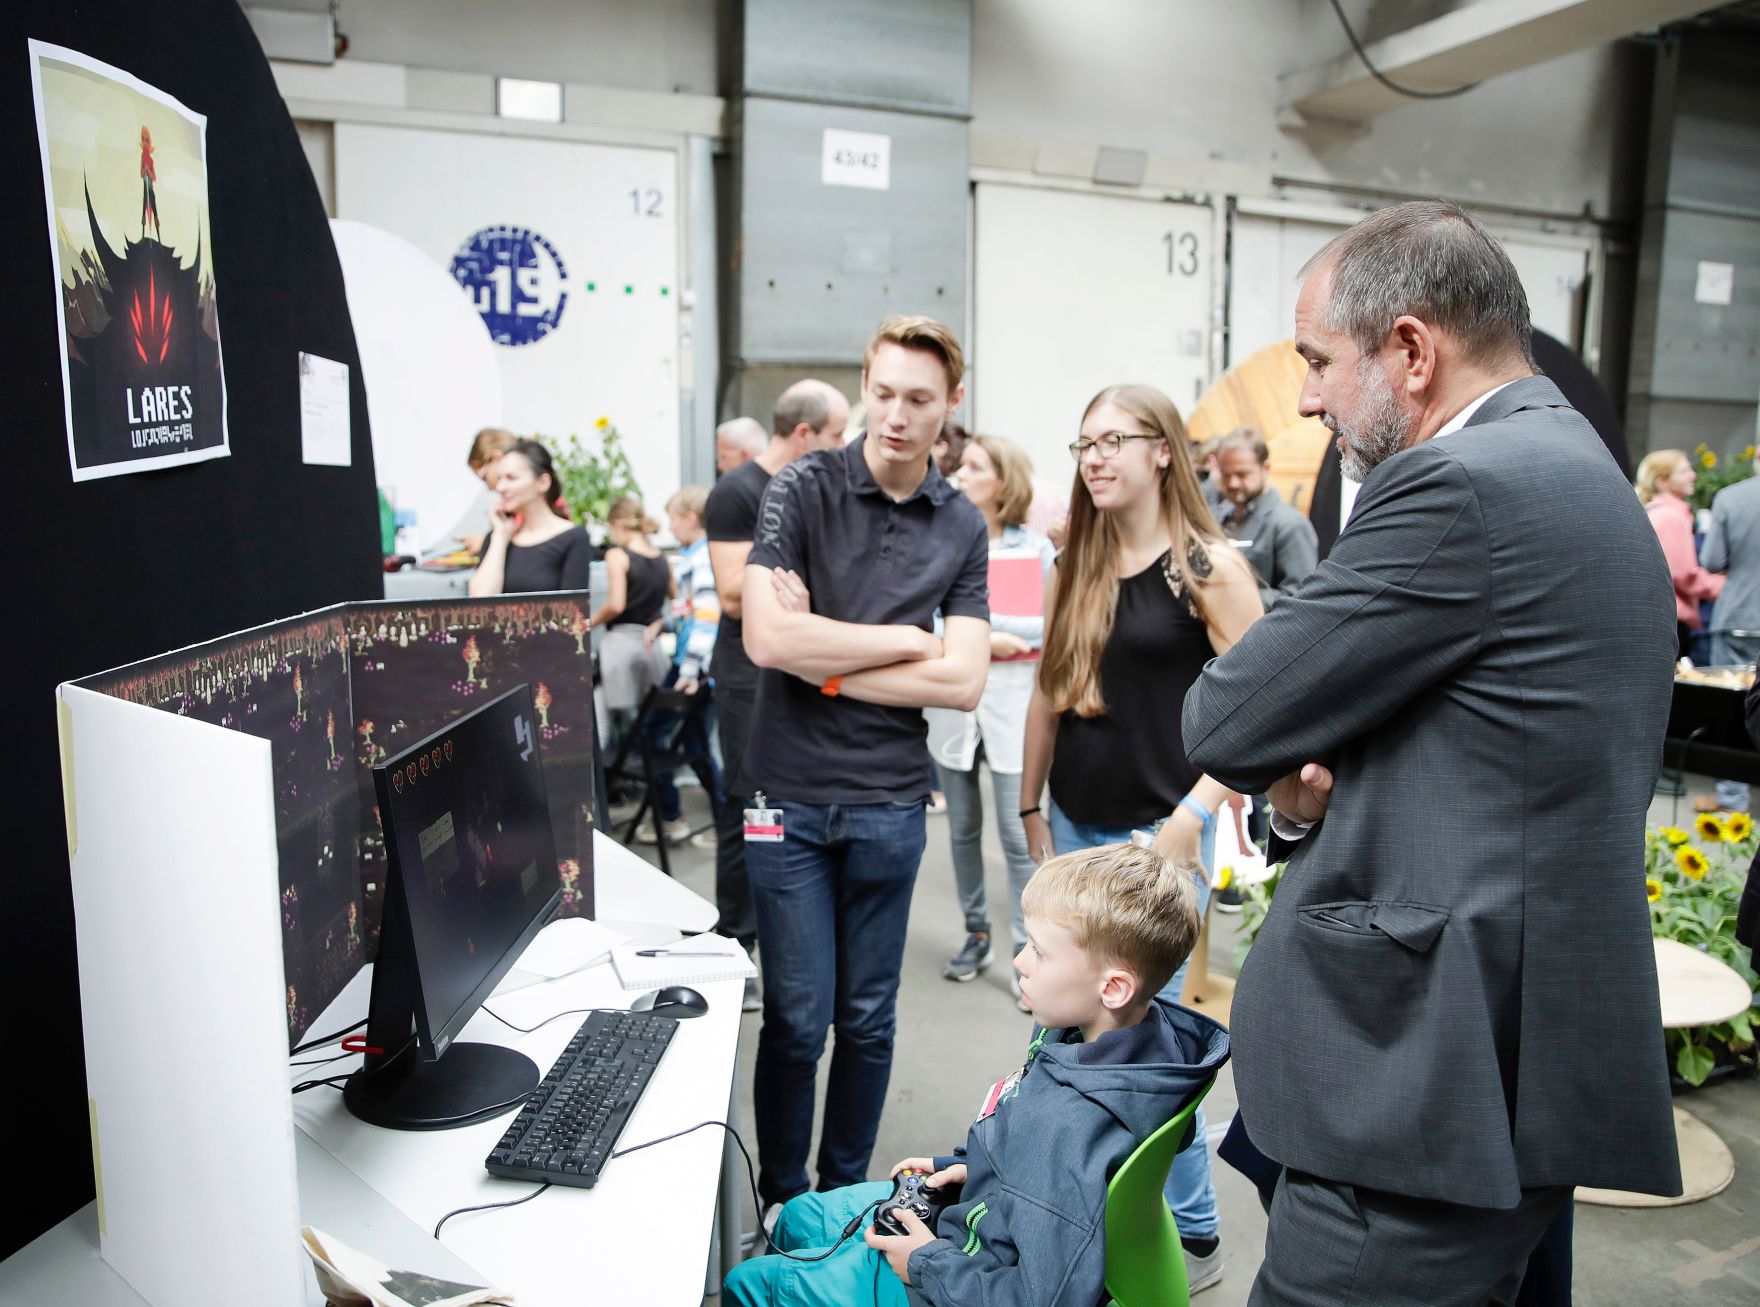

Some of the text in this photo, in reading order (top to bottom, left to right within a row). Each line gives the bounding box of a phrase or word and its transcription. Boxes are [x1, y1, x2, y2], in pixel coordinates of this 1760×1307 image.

[628, 188, 663, 217] 12
[1162, 231, 1199, 276] 13
[126, 385, 193, 424] LARES
